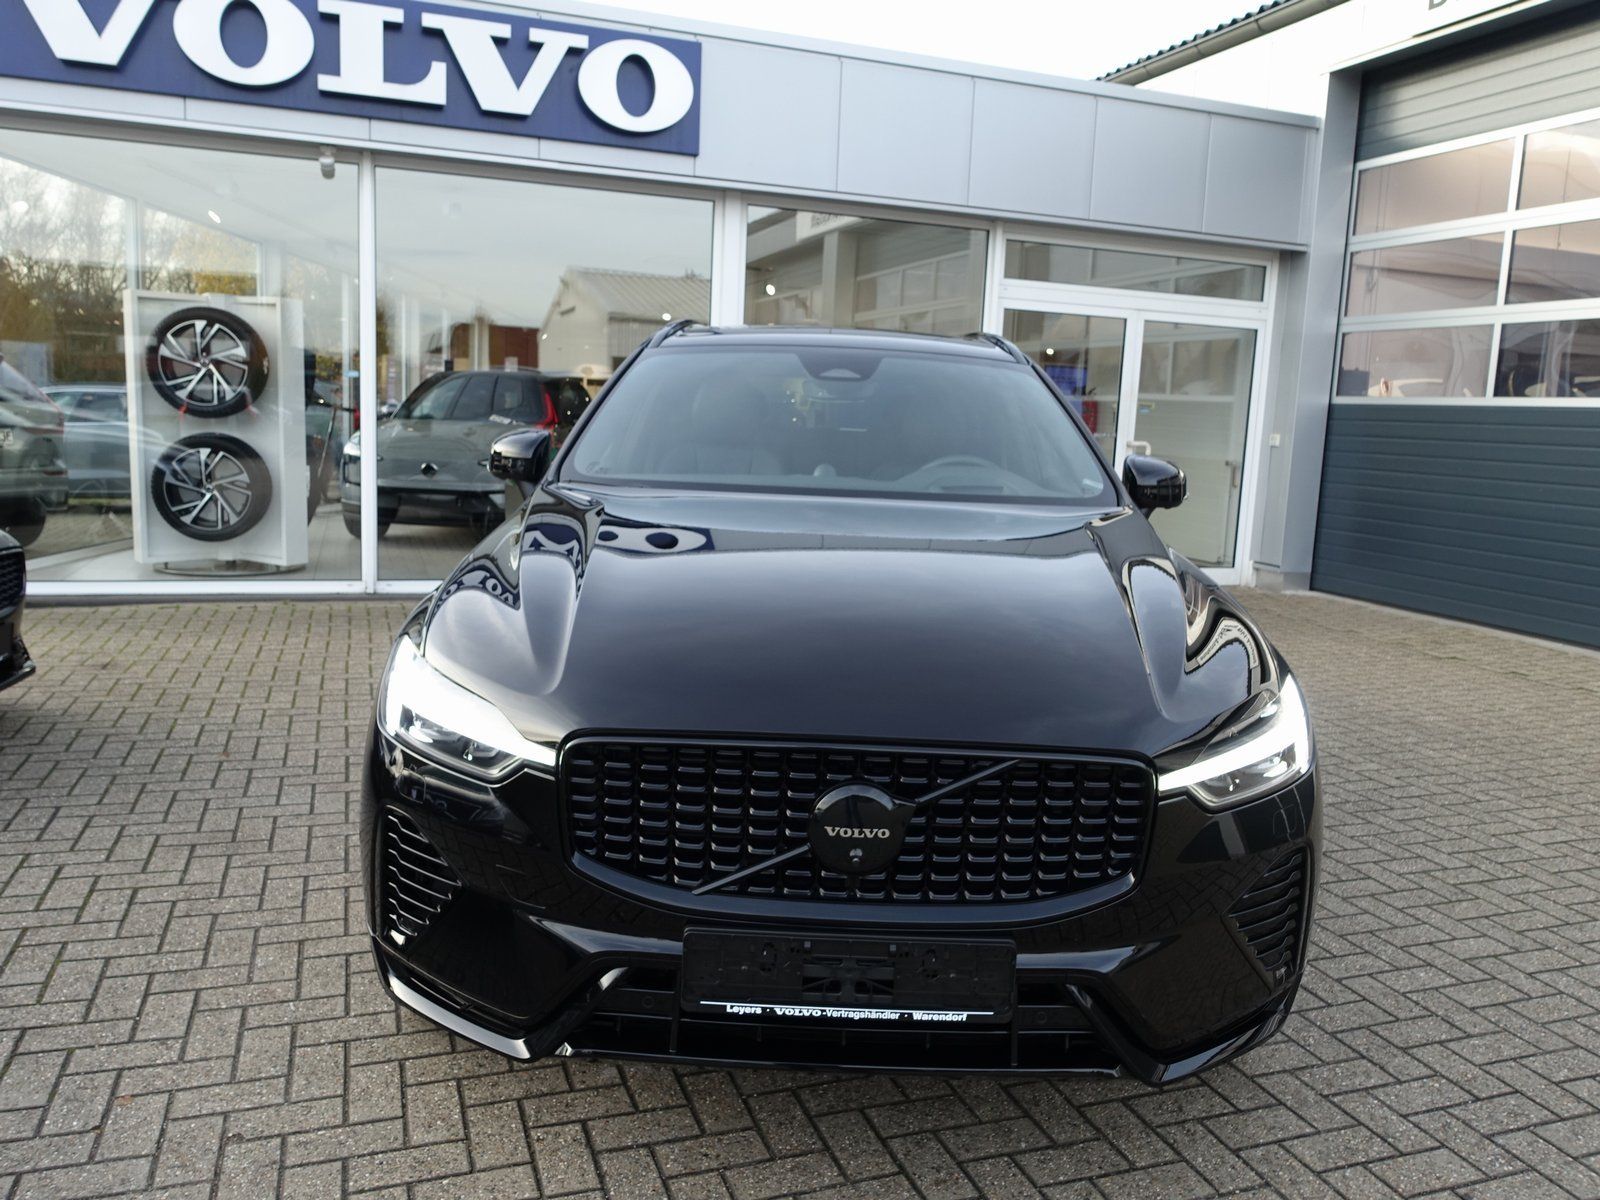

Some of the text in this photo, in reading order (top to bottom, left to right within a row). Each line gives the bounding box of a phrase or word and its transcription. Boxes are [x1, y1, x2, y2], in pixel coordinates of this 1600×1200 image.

[22, 0, 694, 133] VOLVO
[824, 826, 890, 838] VOLVO
[726, 1004, 762, 1015] Leyers
[912, 1012, 968, 1021] Warendorf
